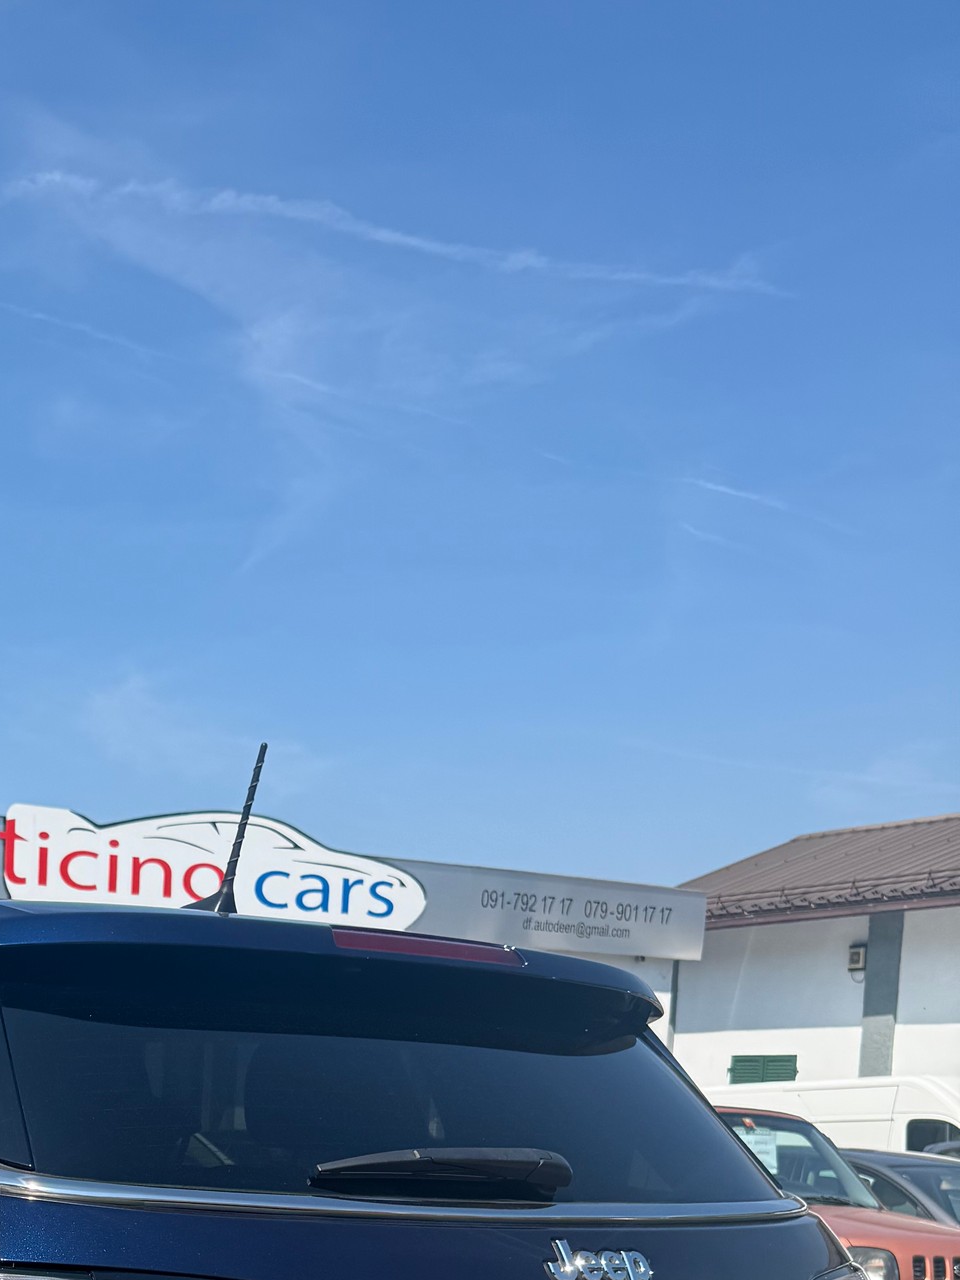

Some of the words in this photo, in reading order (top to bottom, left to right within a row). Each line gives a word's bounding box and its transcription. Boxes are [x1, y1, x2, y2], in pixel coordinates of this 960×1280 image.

[254, 869, 395, 918] cars
[481, 889, 537, 913] 091-792
[541, 895, 556, 915] 17
[560, 897, 573, 916] 17
[584, 900, 639, 923] 079-901
[643, 905, 657, 923] 17
[660, 907, 673, 925] 17
[522, 917, 630, 939] df.autodeen@gmail.com
